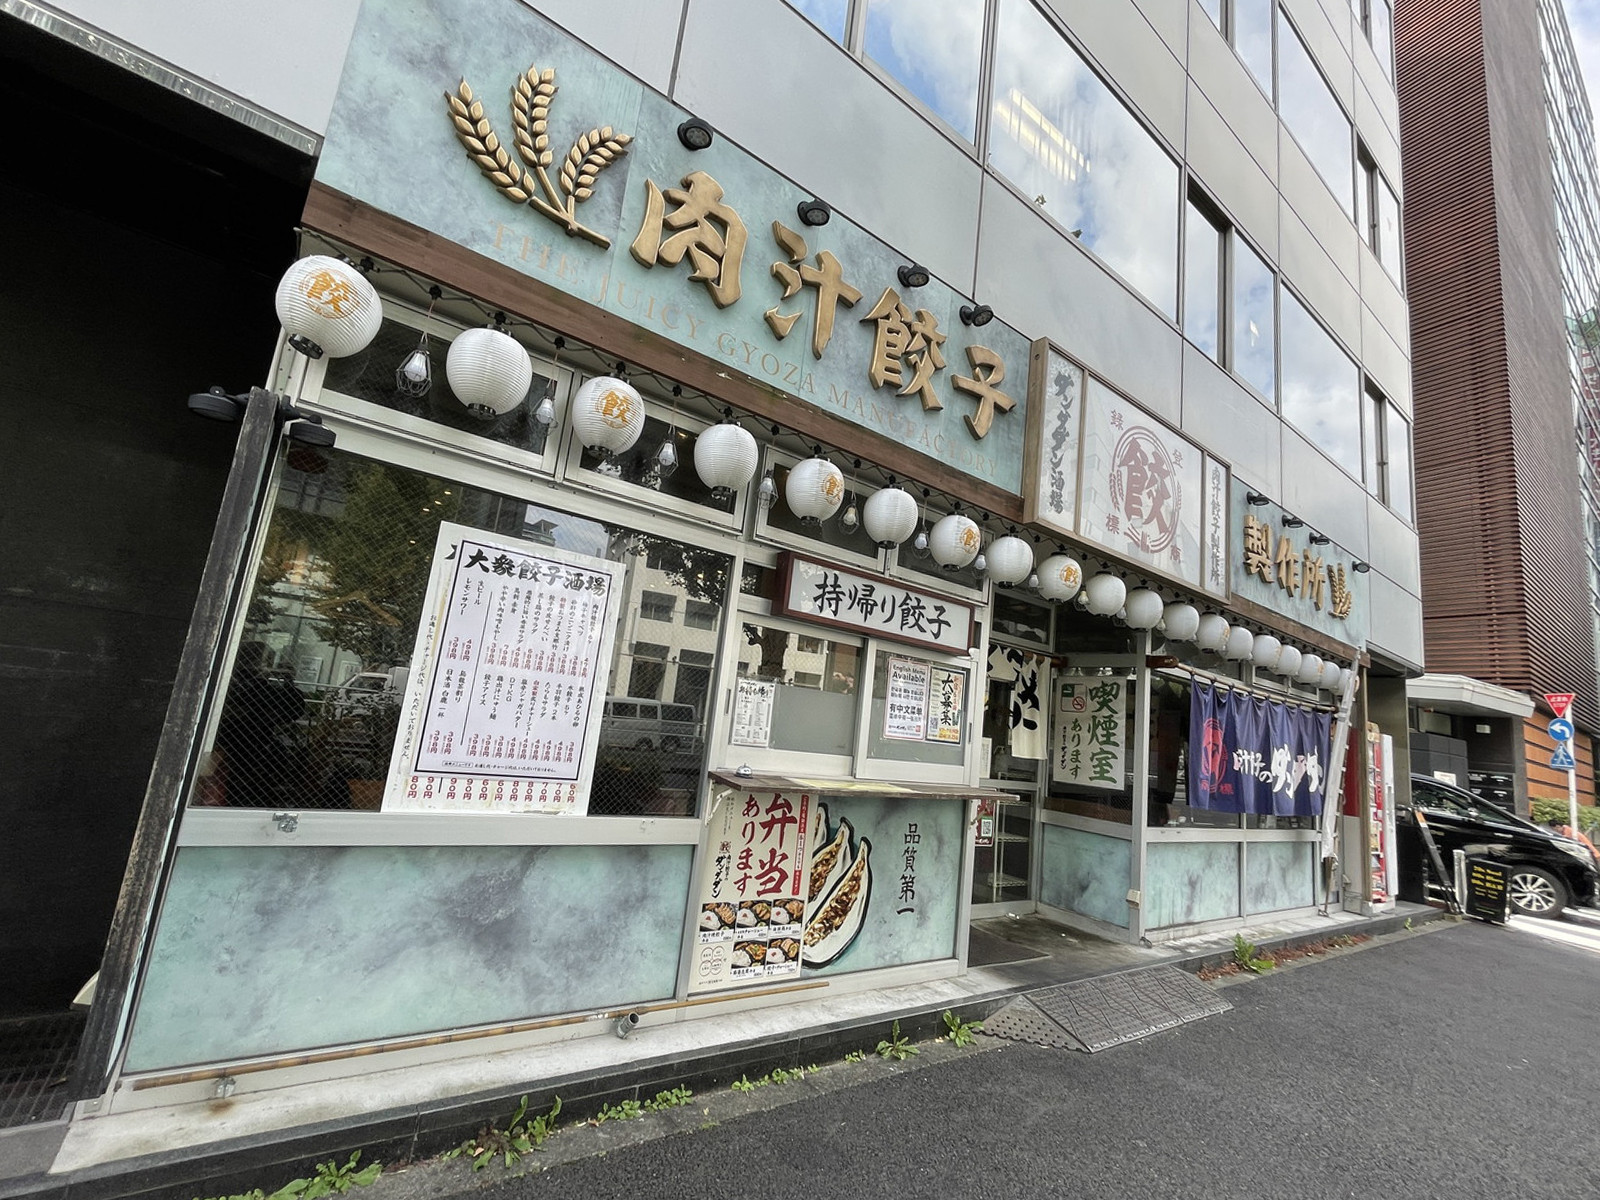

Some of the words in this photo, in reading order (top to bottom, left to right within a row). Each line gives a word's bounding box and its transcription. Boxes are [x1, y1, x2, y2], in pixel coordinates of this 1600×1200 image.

[307, 271, 351, 315] 餃
[631, 171, 1016, 440] 肉汁餃子
[489, 219, 578, 285] THE
[594, 273, 705, 339] JUICY
[718, 332, 816, 394] GYOZA
[828, 384, 998, 479] MANUFACTORY
[603, 391, 630, 423] 餃
[1050, 371, 1075, 515] ダンダダン酒場
[1118, 437, 1171, 535] 餃
[464, 548, 606, 597] 大衆餃子酒場
[1243, 515, 1326, 611] 製作所
[458, 577, 472, 615] レモンサワー
[473, 579, 485, 605] 生ビール
[813, 571, 951, 640] 持帰り餃子
[442, 668, 453, 688] 日本酒
[478, 673, 491, 706] 餃子アイス
[505, 677, 516, 702] DTKG
[892, 672, 925, 684] Available
[893, 664, 912, 672] English
[436, 706, 446, 718] 一杯
[565, 684, 574, 702] 水餃子
[940, 673, 954, 726] 大募集
[1069, 718, 1082, 780] あります
[1087, 681, 1120, 784] 喫煙室
[733, 794, 760, 898] あります
[754, 793, 798, 897] 弁当
[896, 822, 921, 915] 品質第一
[712, 854, 726, 898] ダンダダン
